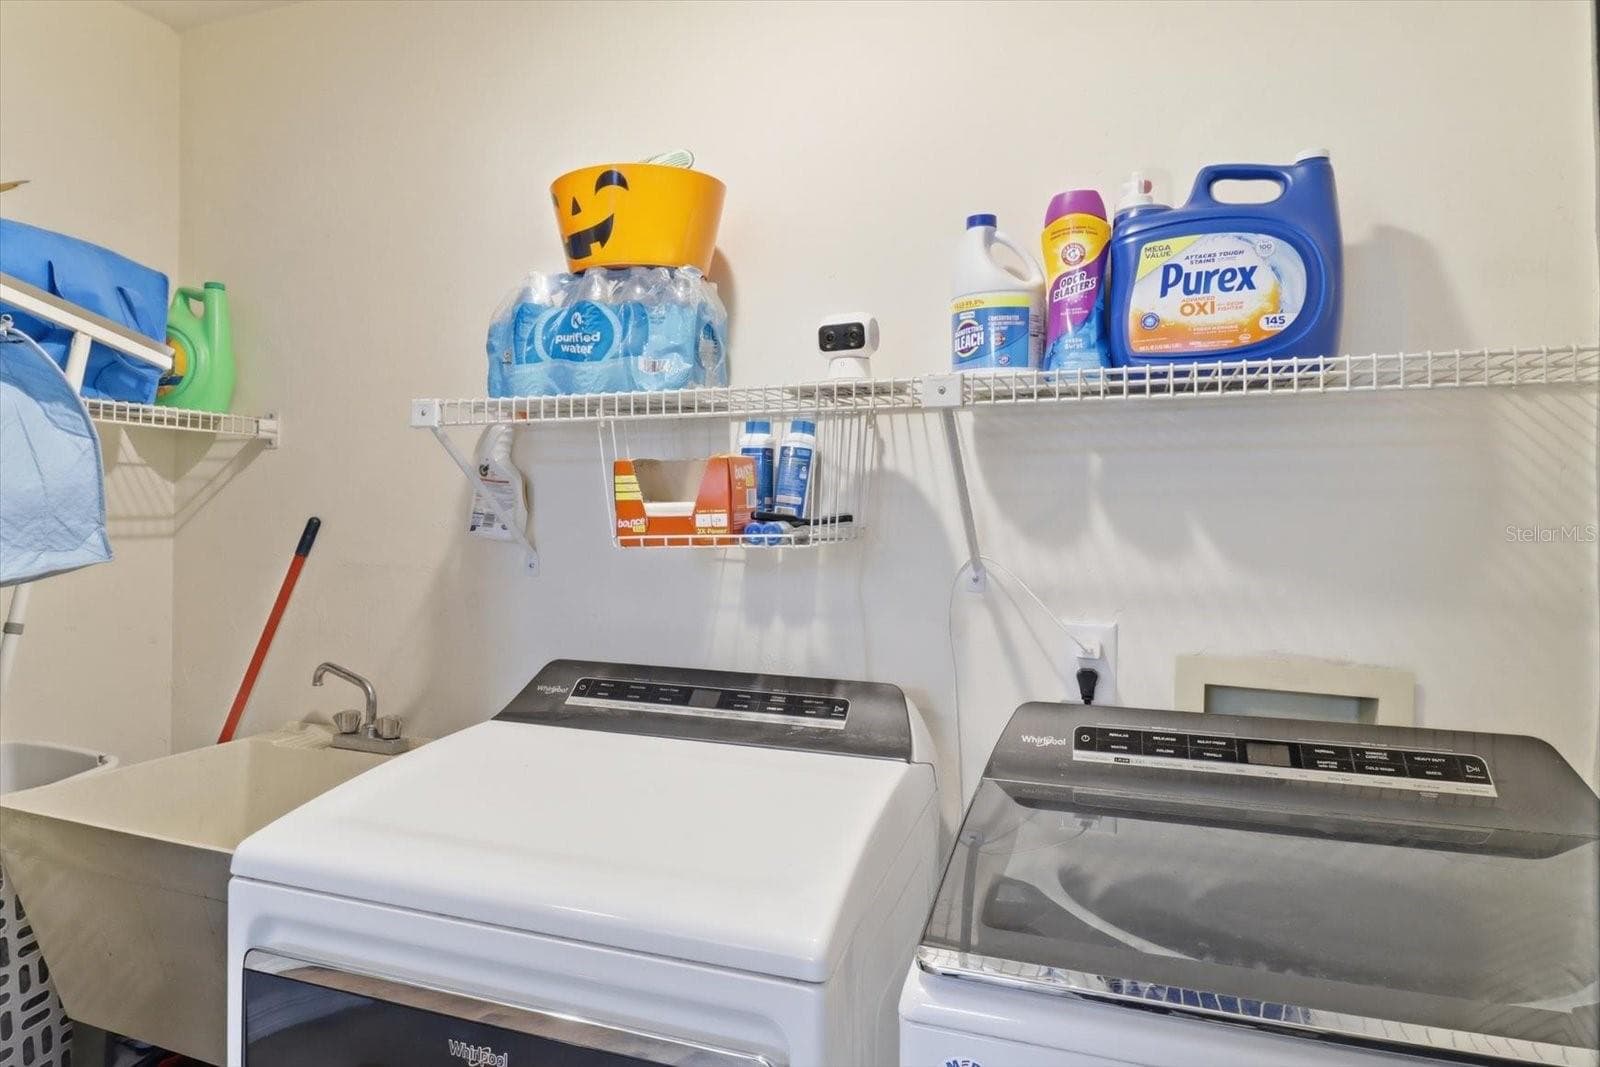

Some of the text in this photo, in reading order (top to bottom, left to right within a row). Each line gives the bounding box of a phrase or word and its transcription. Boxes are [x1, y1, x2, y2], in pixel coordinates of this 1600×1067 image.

[1145, 244, 1171, 253] MEGA
[1184, 252, 1217, 261] ATTACKS
[1219, 249, 1245, 257] TOUGH
[1145, 251, 1171, 260] VALUE
[1060, 271, 1087, 289] ODOR
[1160, 263, 1258, 298] Purex
[1053, 278, 1097, 302] BLASTERS
[1179, 302, 1216, 317] OXI
[1265, 315, 1287, 326] 145
[555, 331, 601, 345] purified
[560, 344, 594, 354] water
[618, 518, 645, 528] bounce
[1021, 734, 1067, 747] Whirlpool
[448, 1038, 509, 1067] Whirlpool
